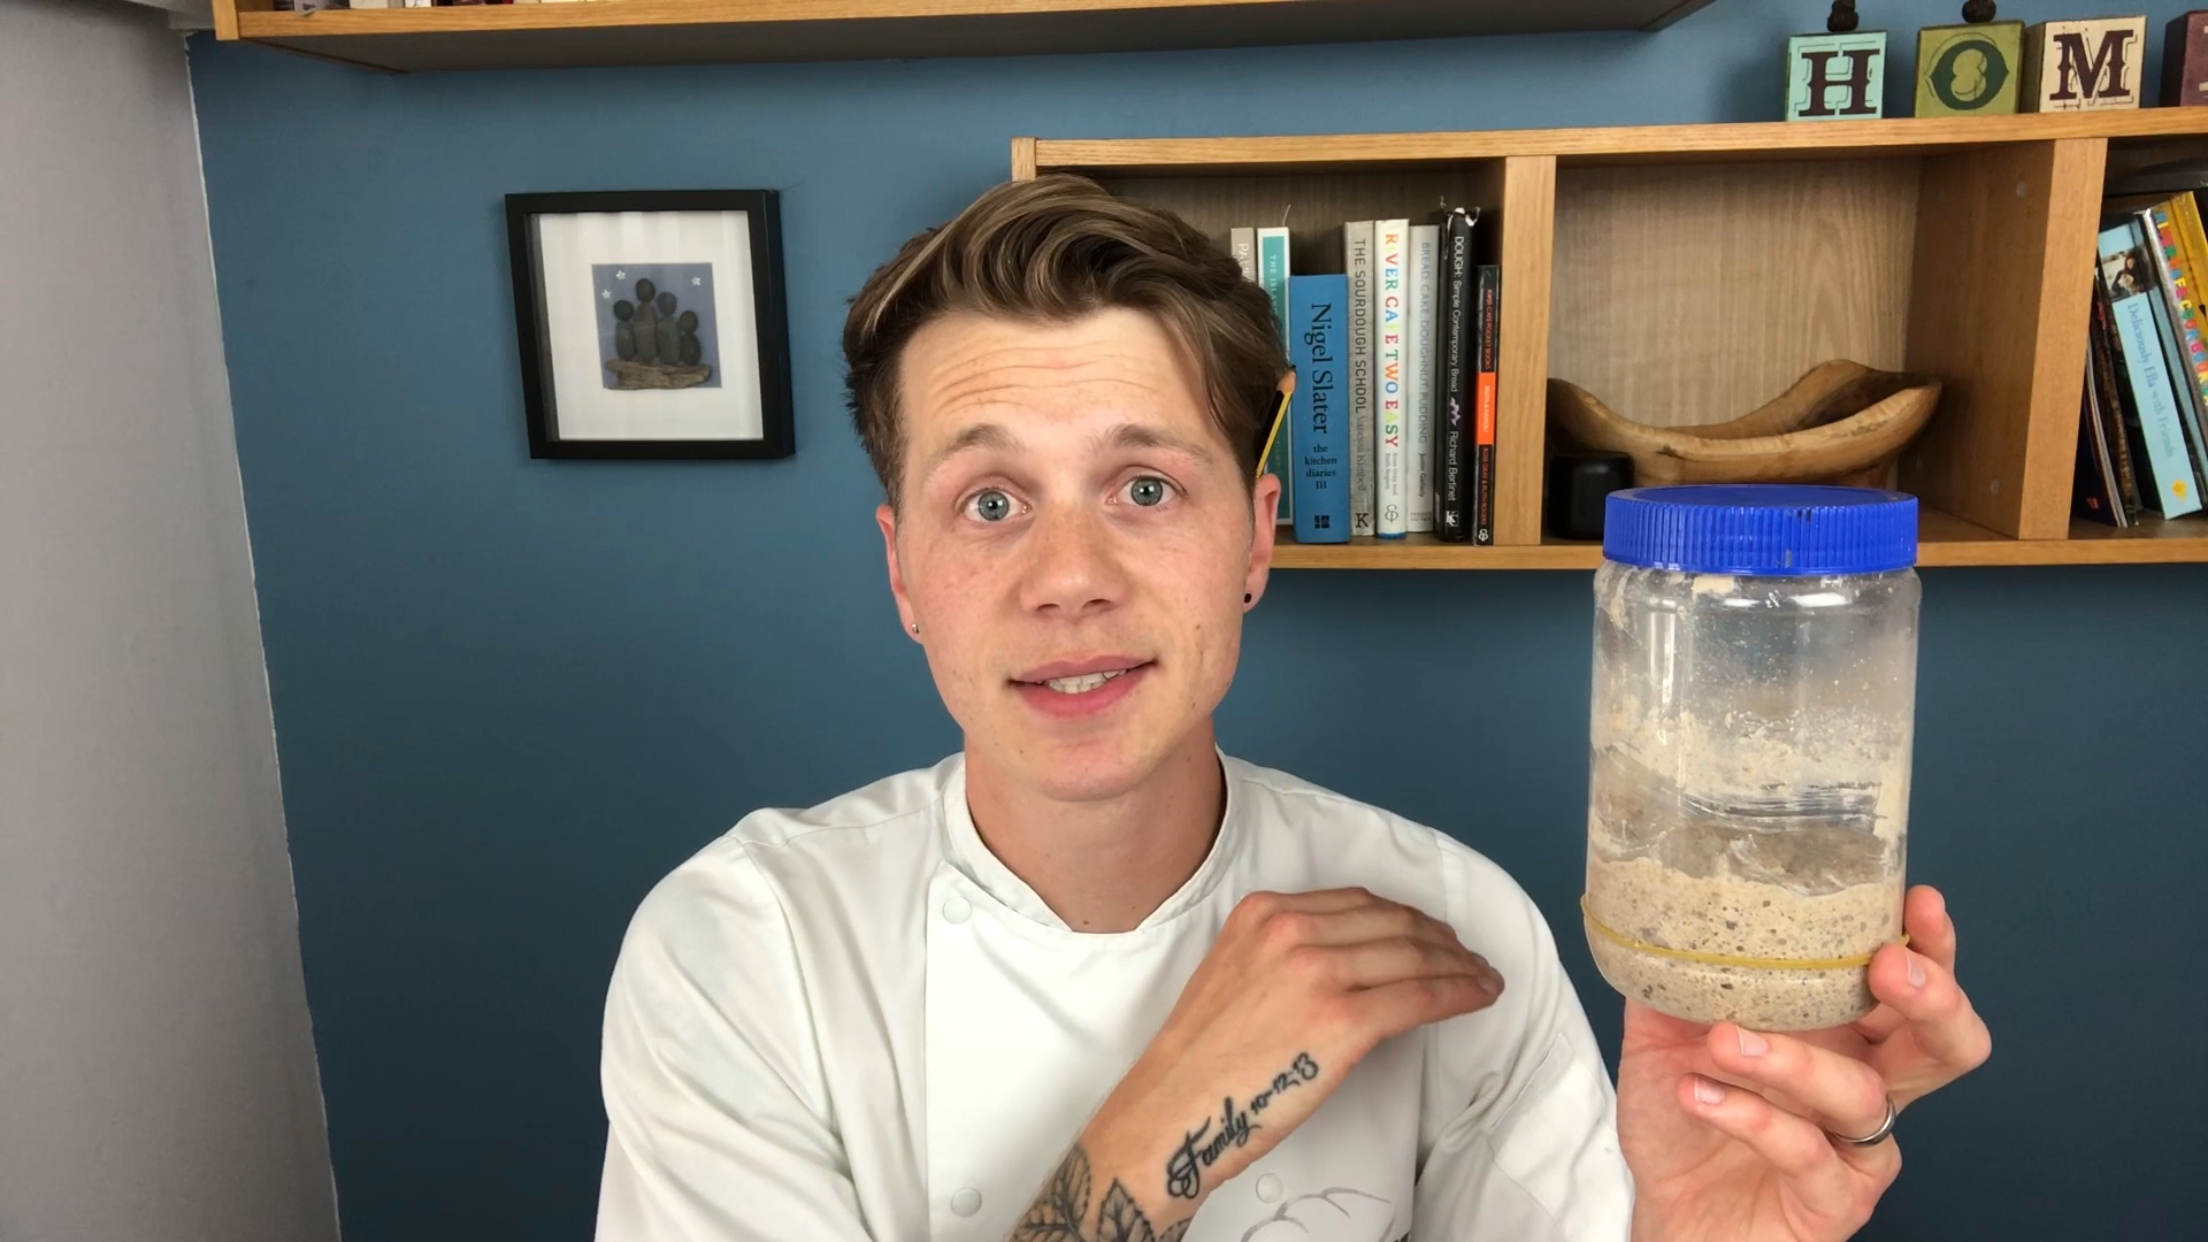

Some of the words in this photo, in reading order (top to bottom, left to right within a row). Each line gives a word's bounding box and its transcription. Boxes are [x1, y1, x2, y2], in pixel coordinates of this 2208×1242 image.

[1354, 239, 1367, 265] THE
[1385, 233, 1399, 290] RIVER
[1453, 236, 1464, 277] DOUGH:
[1354, 270, 1367, 355] SOURDOUGH
[1452, 280, 1462, 308] Simple
[1304, 303, 1333, 364] Nigel
[1450, 309, 1461, 367] Contemporary
[2127, 303, 2150, 364] Deliciously
[1355, 360, 1367, 413] SCHOOL
[1385, 349, 1399, 394] TWO
[1450, 368, 1460, 392] Bread
[2143, 366, 2156, 388] Ella
[1312, 369, 1334, 434] Slater
[1418, 392, 1428, 444] PUDDING
[2151, 389, 2164, 416] with
[1385, 400, 1399, 447] EASY
[2157, 416, 2175, 458] Friends
[1304, 456, 1337, 465] kitchen
[1313, 444, 1328, 453] the
[1449, 431, 1459, 465] Richard
[1306, 469, 1336, 477] diaries
[1448, 467, 1458, 501] Bertinet
[1355, 512, 1370, 529] K
[1166, 1096, 1262, 1199] Family
